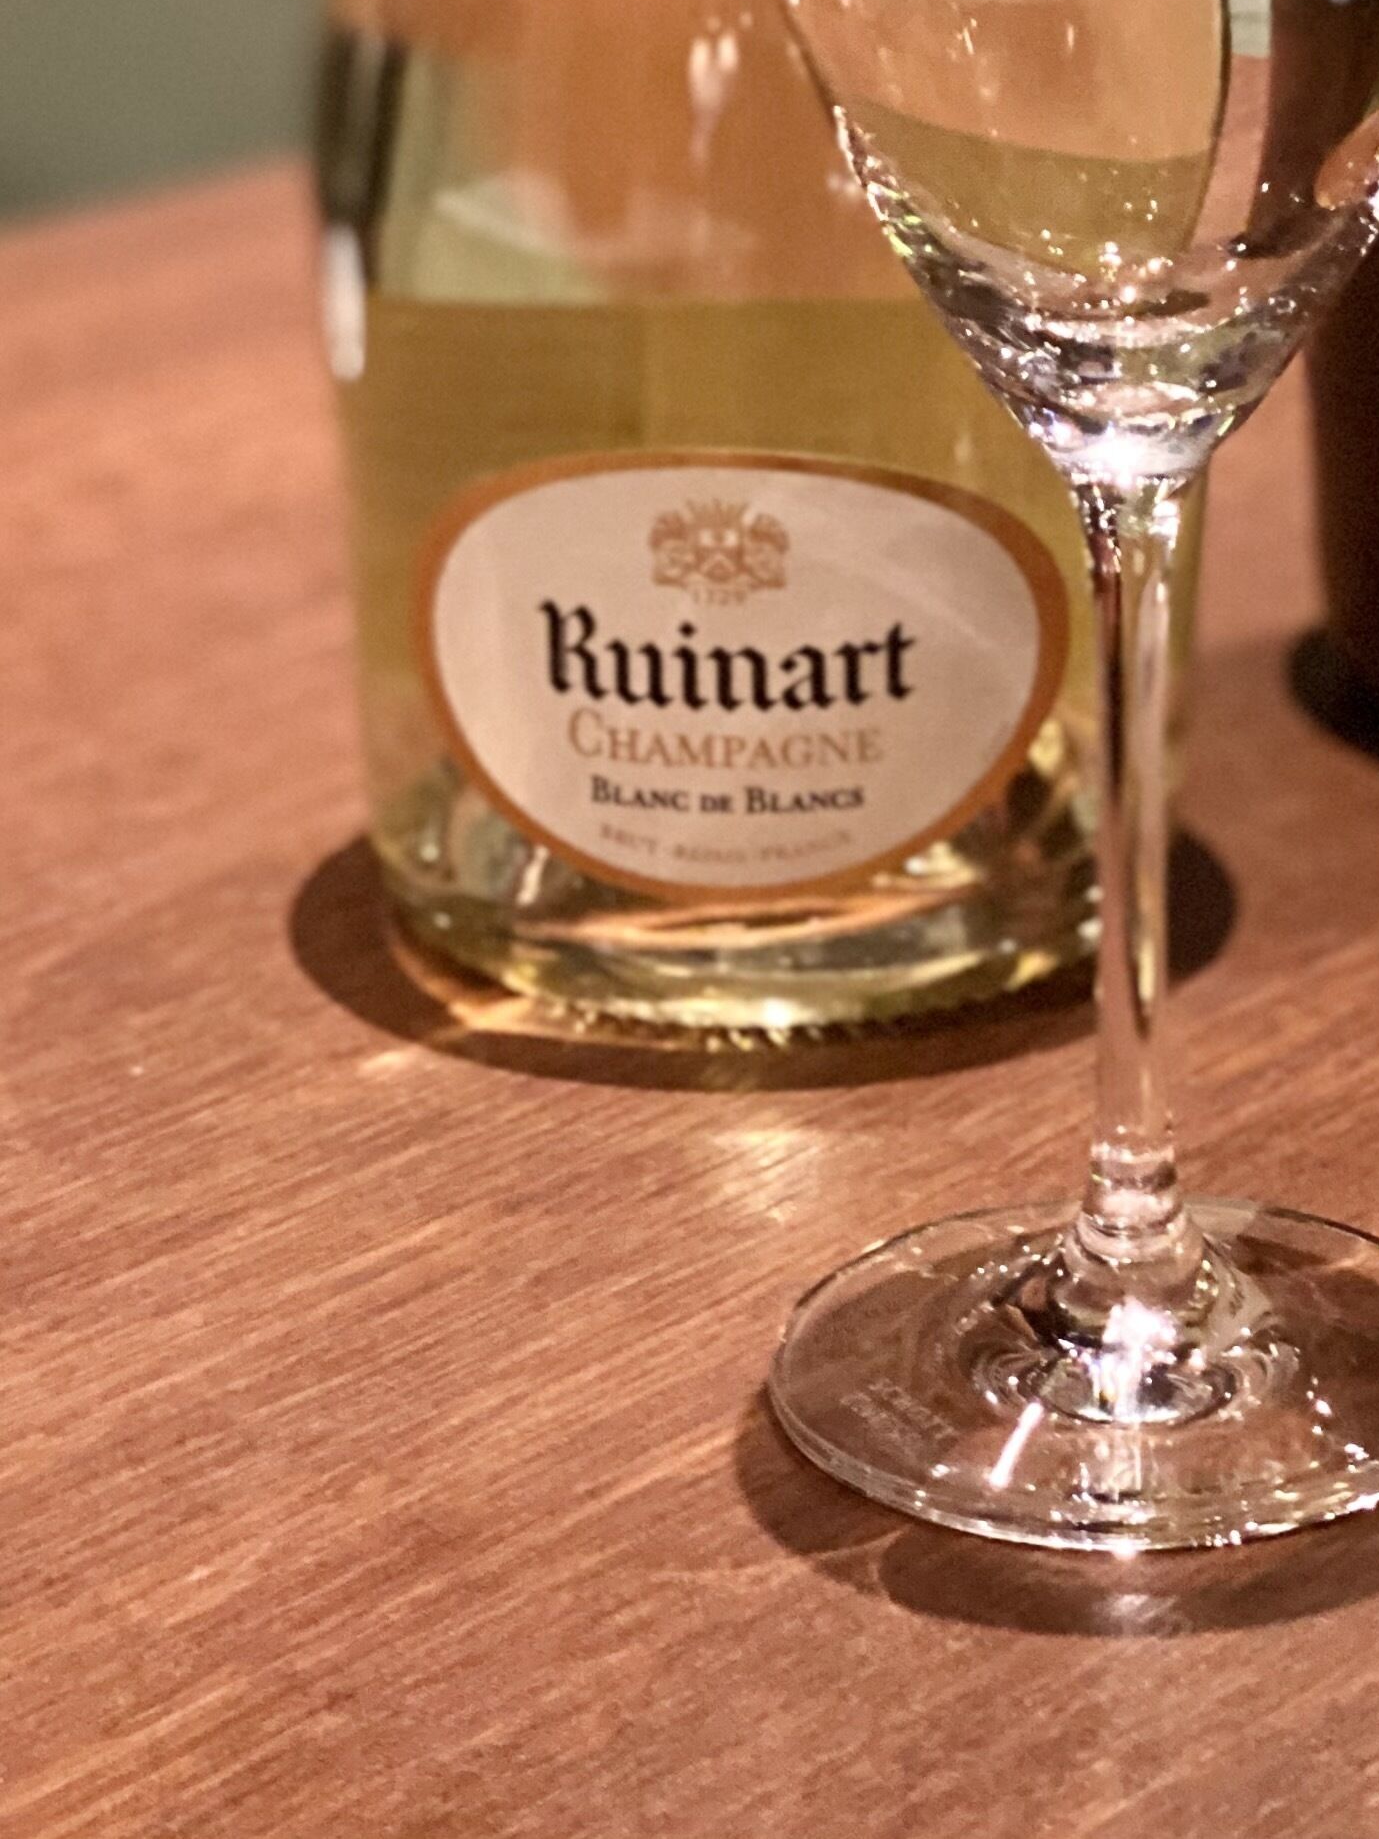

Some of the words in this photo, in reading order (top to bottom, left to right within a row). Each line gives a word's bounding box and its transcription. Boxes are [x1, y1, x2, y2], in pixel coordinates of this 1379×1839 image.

[538, 599, 917, 713] Ruinart
[567, 706, 884, 770] CHAMPAGNE
[589, 773, 690, 812] BLANC
[744, 785, 864, 815] BLANCS
